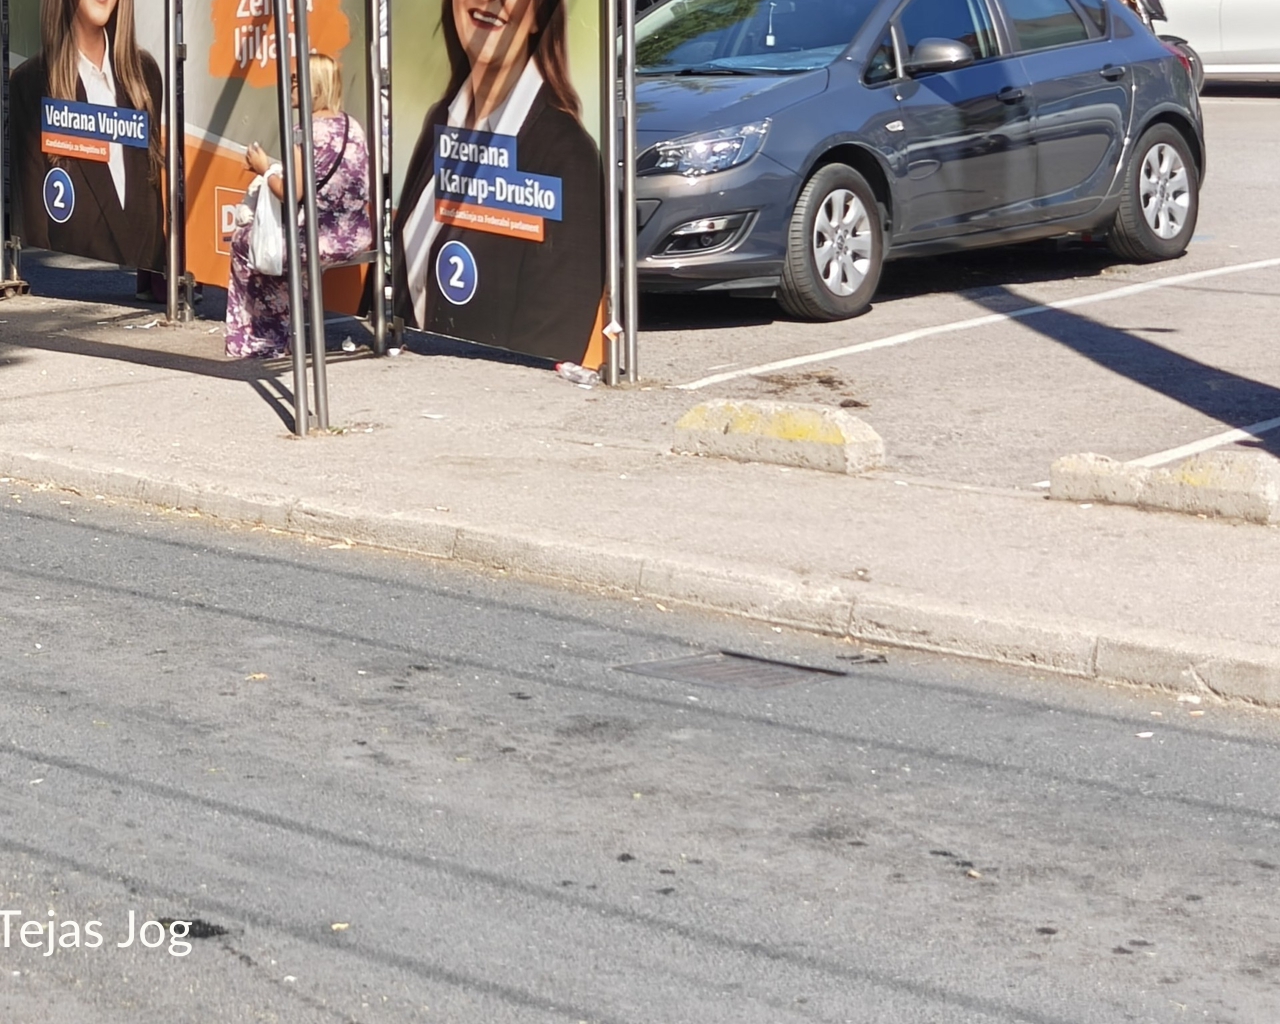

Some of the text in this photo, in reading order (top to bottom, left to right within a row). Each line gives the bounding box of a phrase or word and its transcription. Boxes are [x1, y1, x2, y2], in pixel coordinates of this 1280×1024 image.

[45, 104, 145, 141] Vedrana Vujović
[439, 132, 509, 168] Dženana
[53, 180, 65, 208] 2
[439, 168, 555, 211] Karup-Druško
[448, 256, 465, 289] 2
